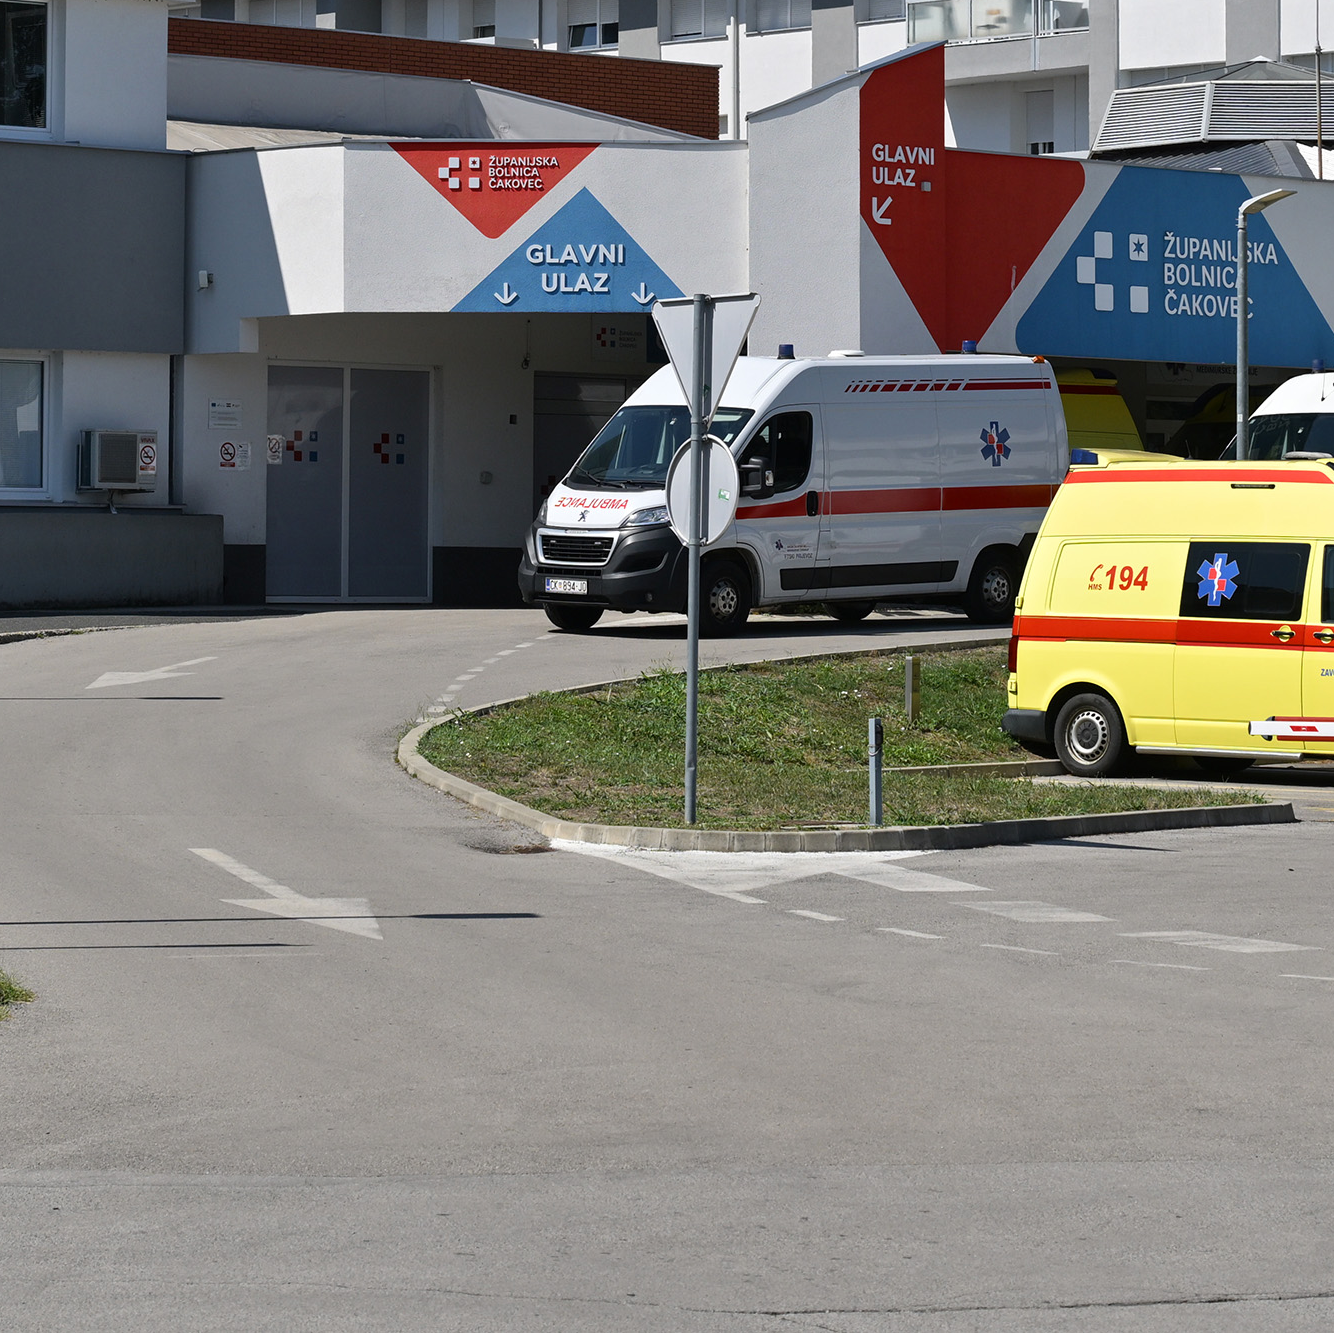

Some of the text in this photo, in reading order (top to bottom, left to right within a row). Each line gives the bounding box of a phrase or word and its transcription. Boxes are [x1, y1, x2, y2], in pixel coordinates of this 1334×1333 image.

[488, 155, 559, 166] ŽUPANIJSKA
[871, 143, 935, 165] GLAVNI
[488, 167, 540, 177] BOLNICA
[872, 166, 916, 186] ULAZ
[488, 177, 543, 188] ČAKOVEC
[526, 243, 624, 264] GLAVNI
[541, 272, 609, 292] ULAZ
[1164, 263, 1238, 289] BOLNIC
[1087, 583, 1103, 591] HMS
[1105, 565, 1149, 591] 194
